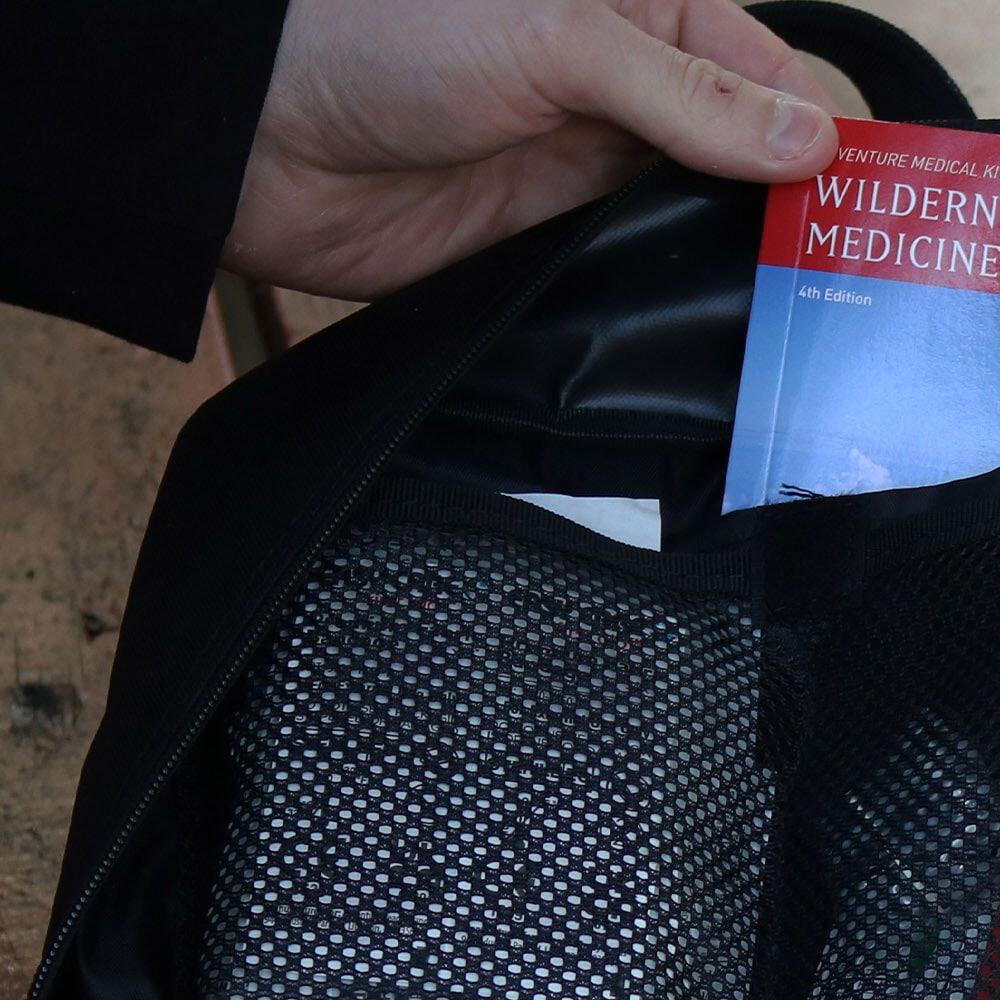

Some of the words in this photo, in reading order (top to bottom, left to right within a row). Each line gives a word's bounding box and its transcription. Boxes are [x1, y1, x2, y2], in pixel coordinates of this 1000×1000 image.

[837, 146, 910, 169] VENTURE
[911, 155, 978, 178] MEDICAL
[798, 285, 821, 300] 4th
[824, 287, 872, 306] Edition
